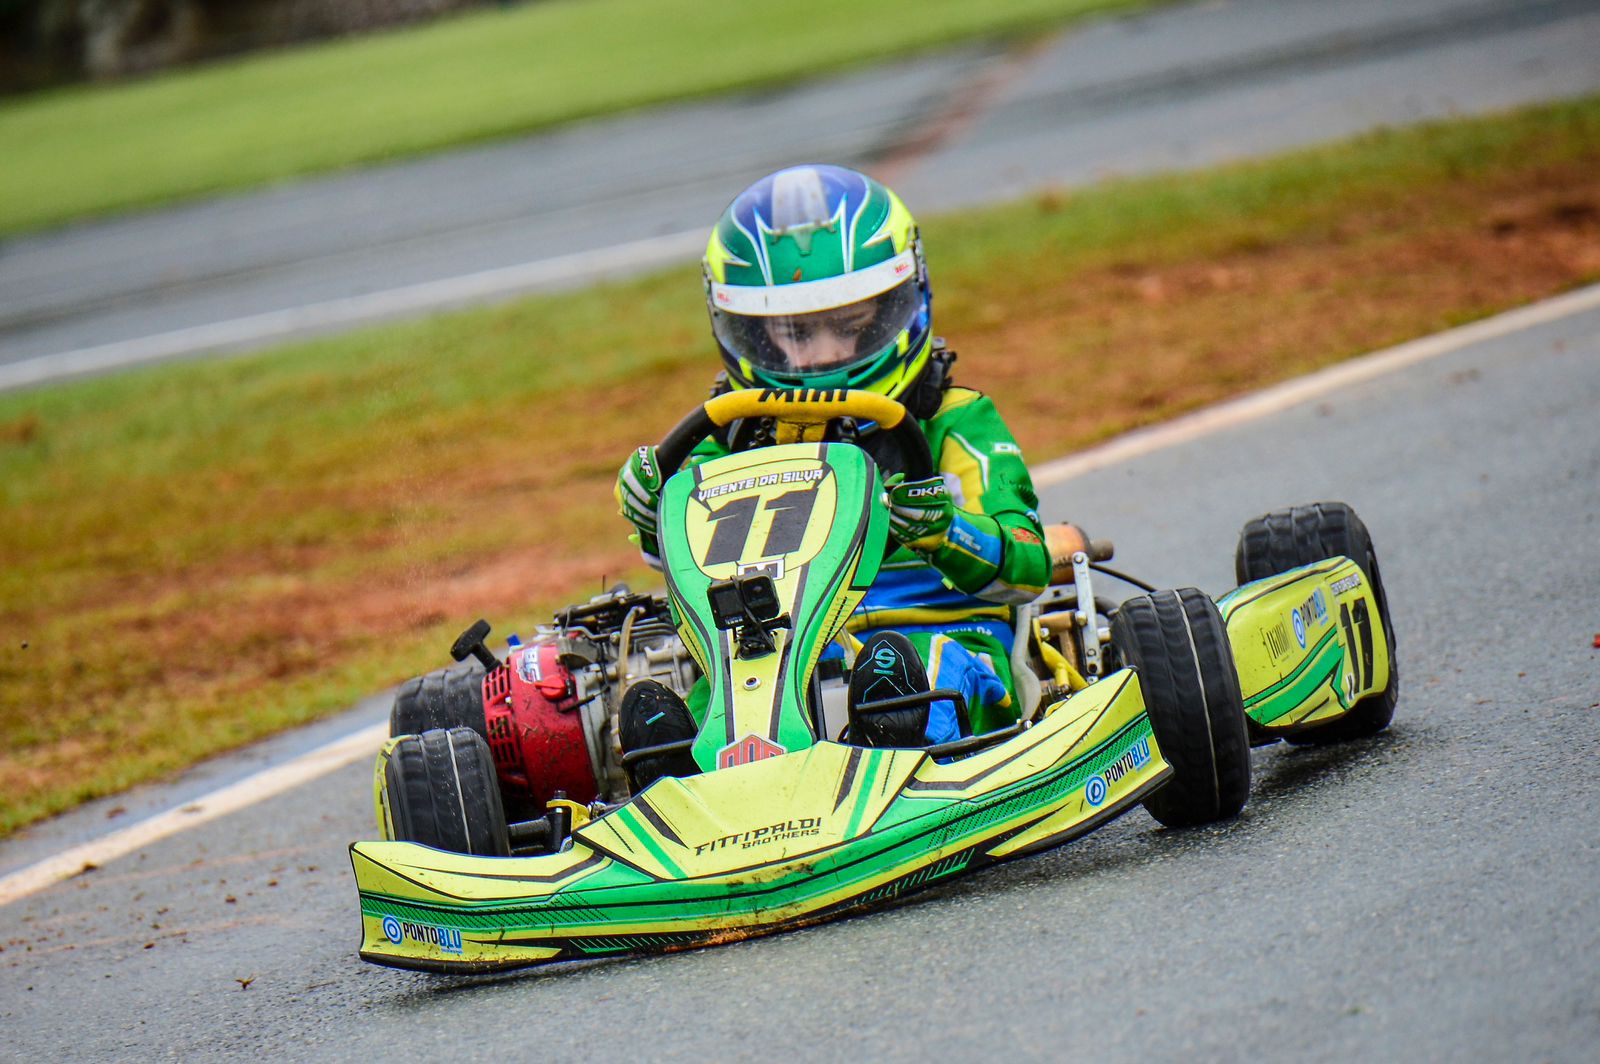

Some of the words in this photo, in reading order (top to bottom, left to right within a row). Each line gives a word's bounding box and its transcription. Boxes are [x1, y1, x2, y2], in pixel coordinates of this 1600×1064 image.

[698, 478, 756, 501] VICENTE
[758, 473, 780, 486] DA
[782, 469, 823, 483] SILVA
[702, 487, 819, 568] 11
[1339, 597, 1374, 694] 11
[1104, 736, 1151, 787] PONTOBLU
[694, 817, 822, 856] FITTIPALDI
[741, 828, 820, 849] BROTHERS
[402, 922, 462, 949] PONTOBLU
